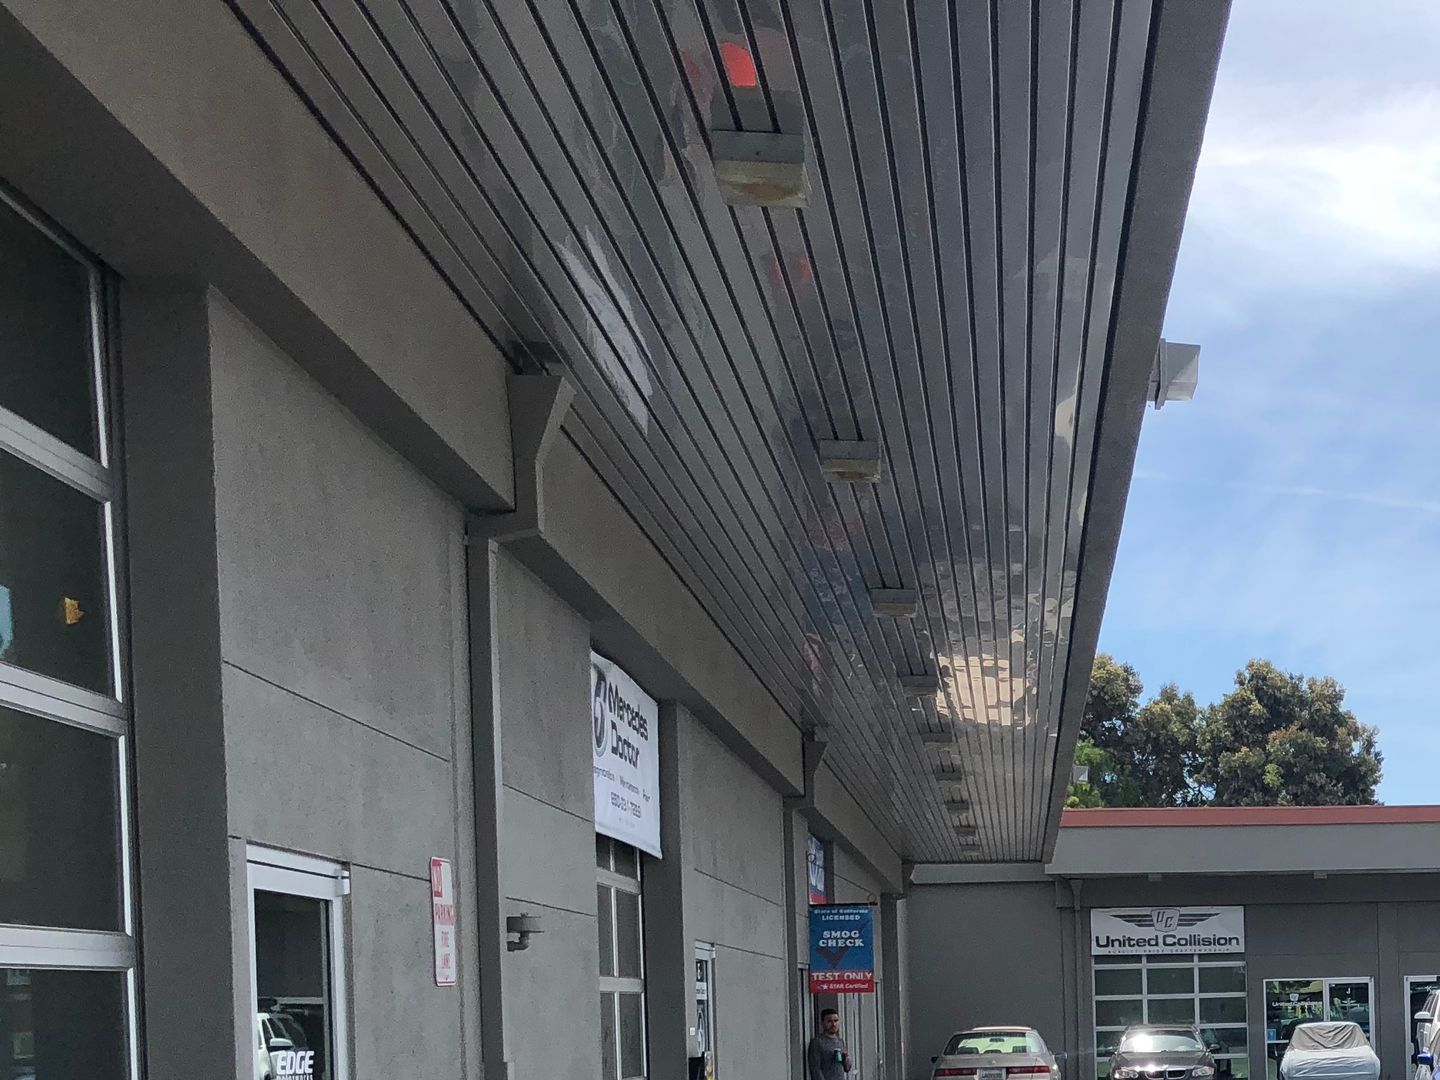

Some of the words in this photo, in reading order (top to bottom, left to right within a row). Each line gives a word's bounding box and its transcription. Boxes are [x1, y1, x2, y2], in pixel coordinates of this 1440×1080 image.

[608, 681, 649, 741] Mercedes
[610, 719, 640, 769] Doctor
[823, 930, 860, 938] SMOG
[1095, 934, 1159, 948] United
[1162, 933, 1240, 947] Collision
[818, 939, 865, 947] CHECK
[812, 972, 840, 980] TEST
[844, 972, 873, 980] ONLY
[277, 1050, 315, 1075] EDGE
